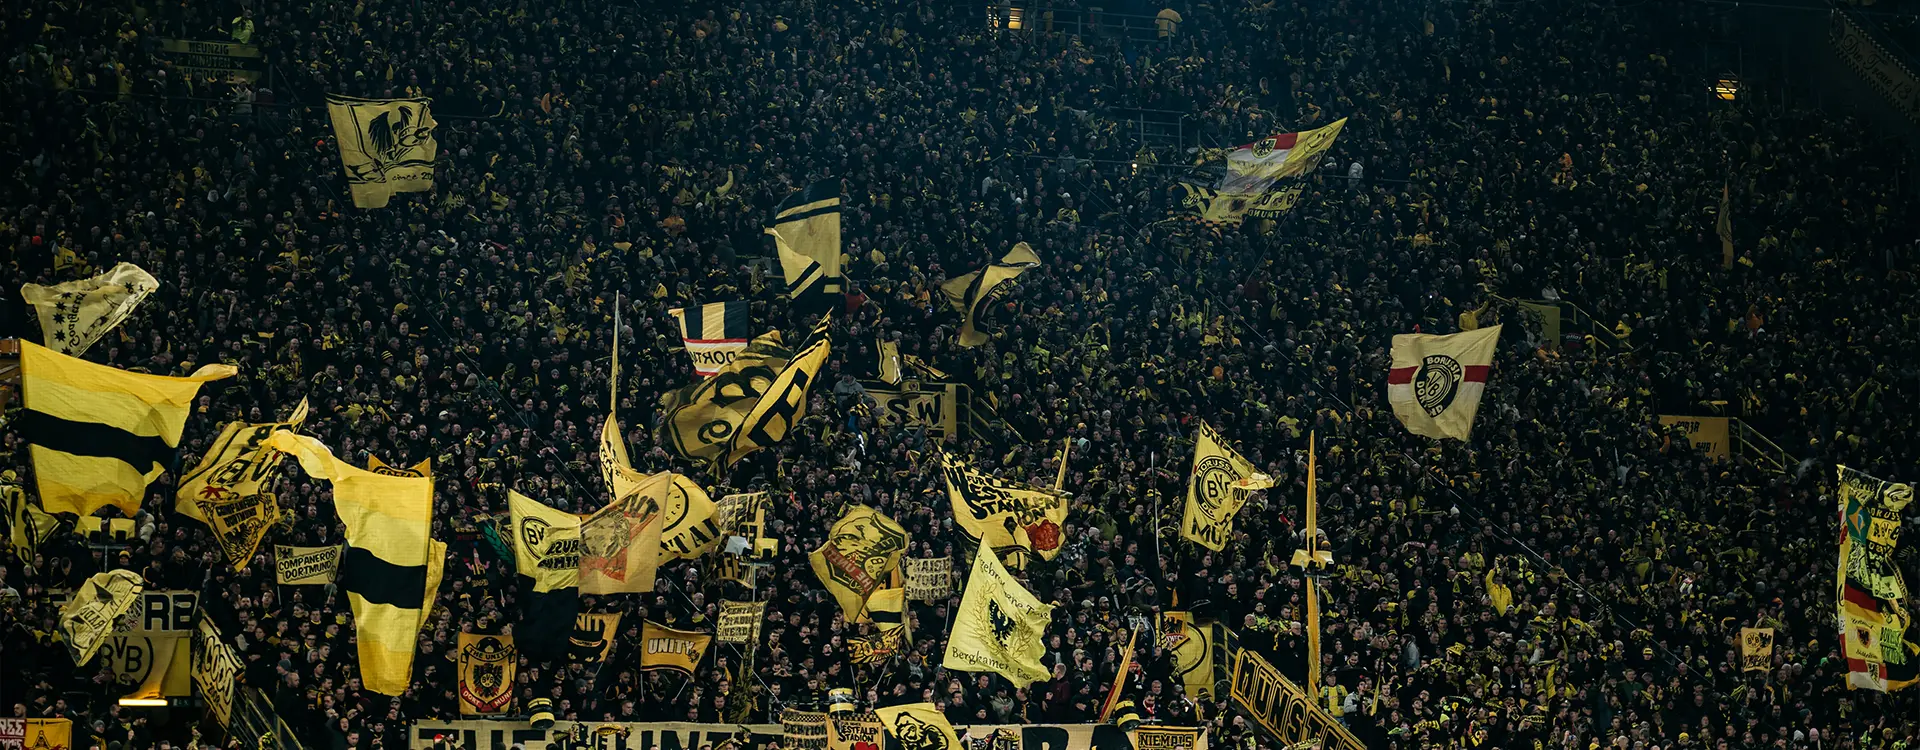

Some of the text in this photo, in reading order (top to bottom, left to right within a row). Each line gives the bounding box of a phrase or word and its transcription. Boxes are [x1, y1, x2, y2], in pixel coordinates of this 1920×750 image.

[188, 42, 229, 55] NEUNZIG
[187, 55, 231, 69] MINUTEN
[278, 549, 336, 572] COMPANEROS
[285, 560, 332, 580] DORTMUND
[468, 647, 511, 660] THE UNITY
[647, 637, 696, 655] UNITY
